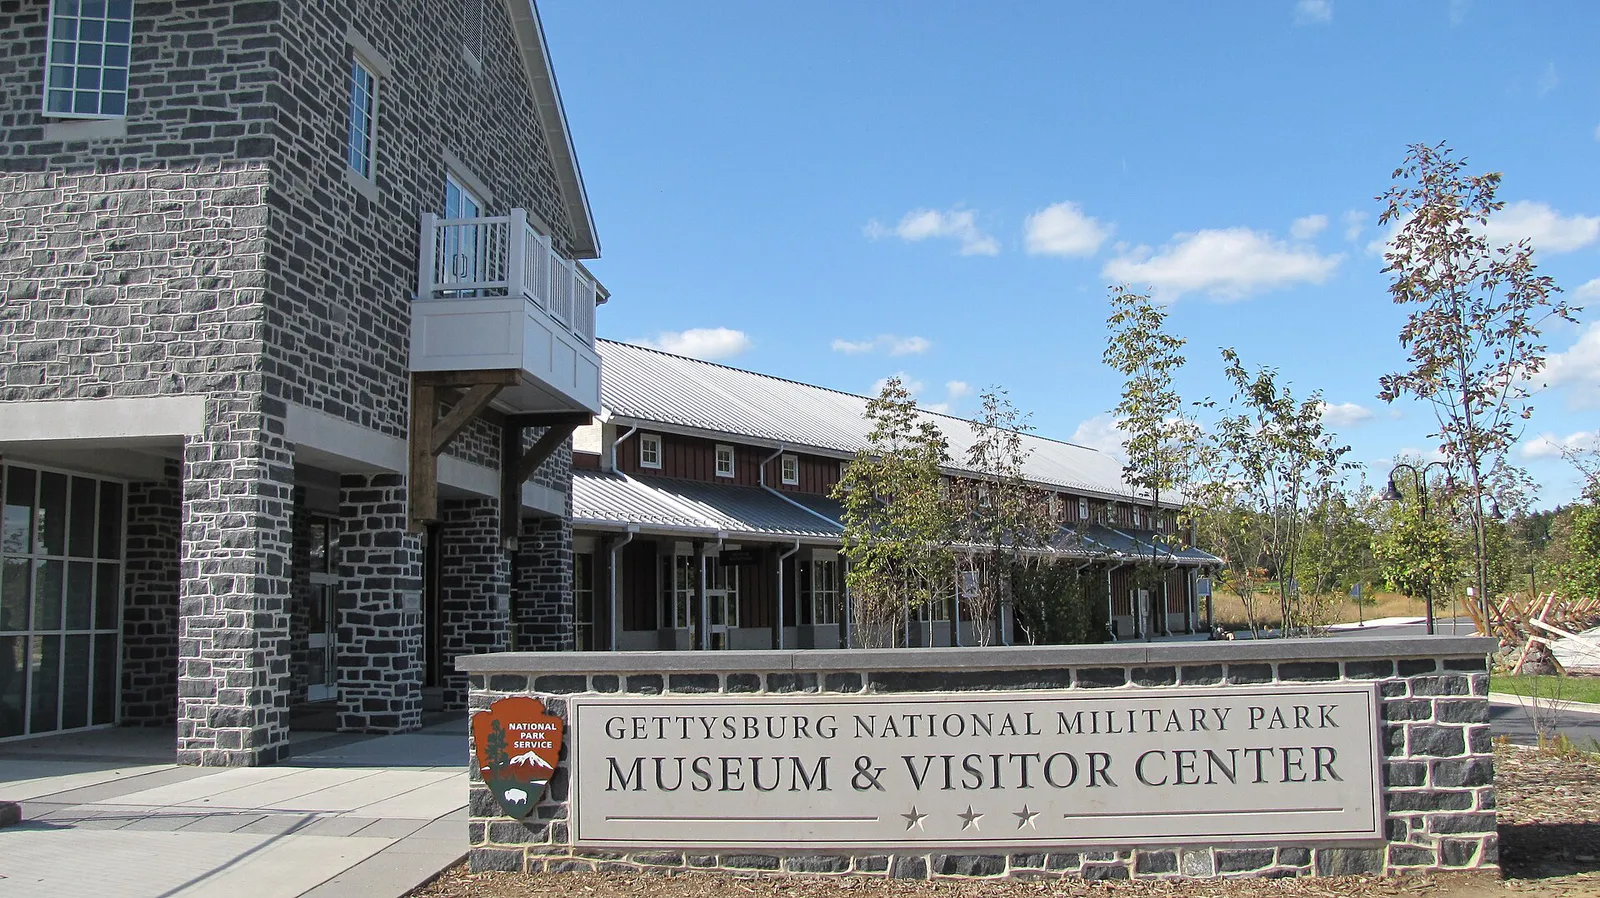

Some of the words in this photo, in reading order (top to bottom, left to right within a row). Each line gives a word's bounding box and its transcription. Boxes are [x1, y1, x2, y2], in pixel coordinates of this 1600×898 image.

[508, 722, 557, 731] NATIONAL
[605, 715, 839, 740] GETTYSBURG
[854, 712, 1042, 737] NATIONAL
[1057, 707, 1231, 735] MILITARY
[1248, 704, 1340, 731] PARK
[520, 732, 545, 740] PARK
[513, 741, 553, 749] SERVICE
[605, 755, 832, 793] MUSEUM
[851, 755, 887, 792] &
[902, 752, 1117, 791] VISITOR
[1134, 746, 1344, 787] CENTER
